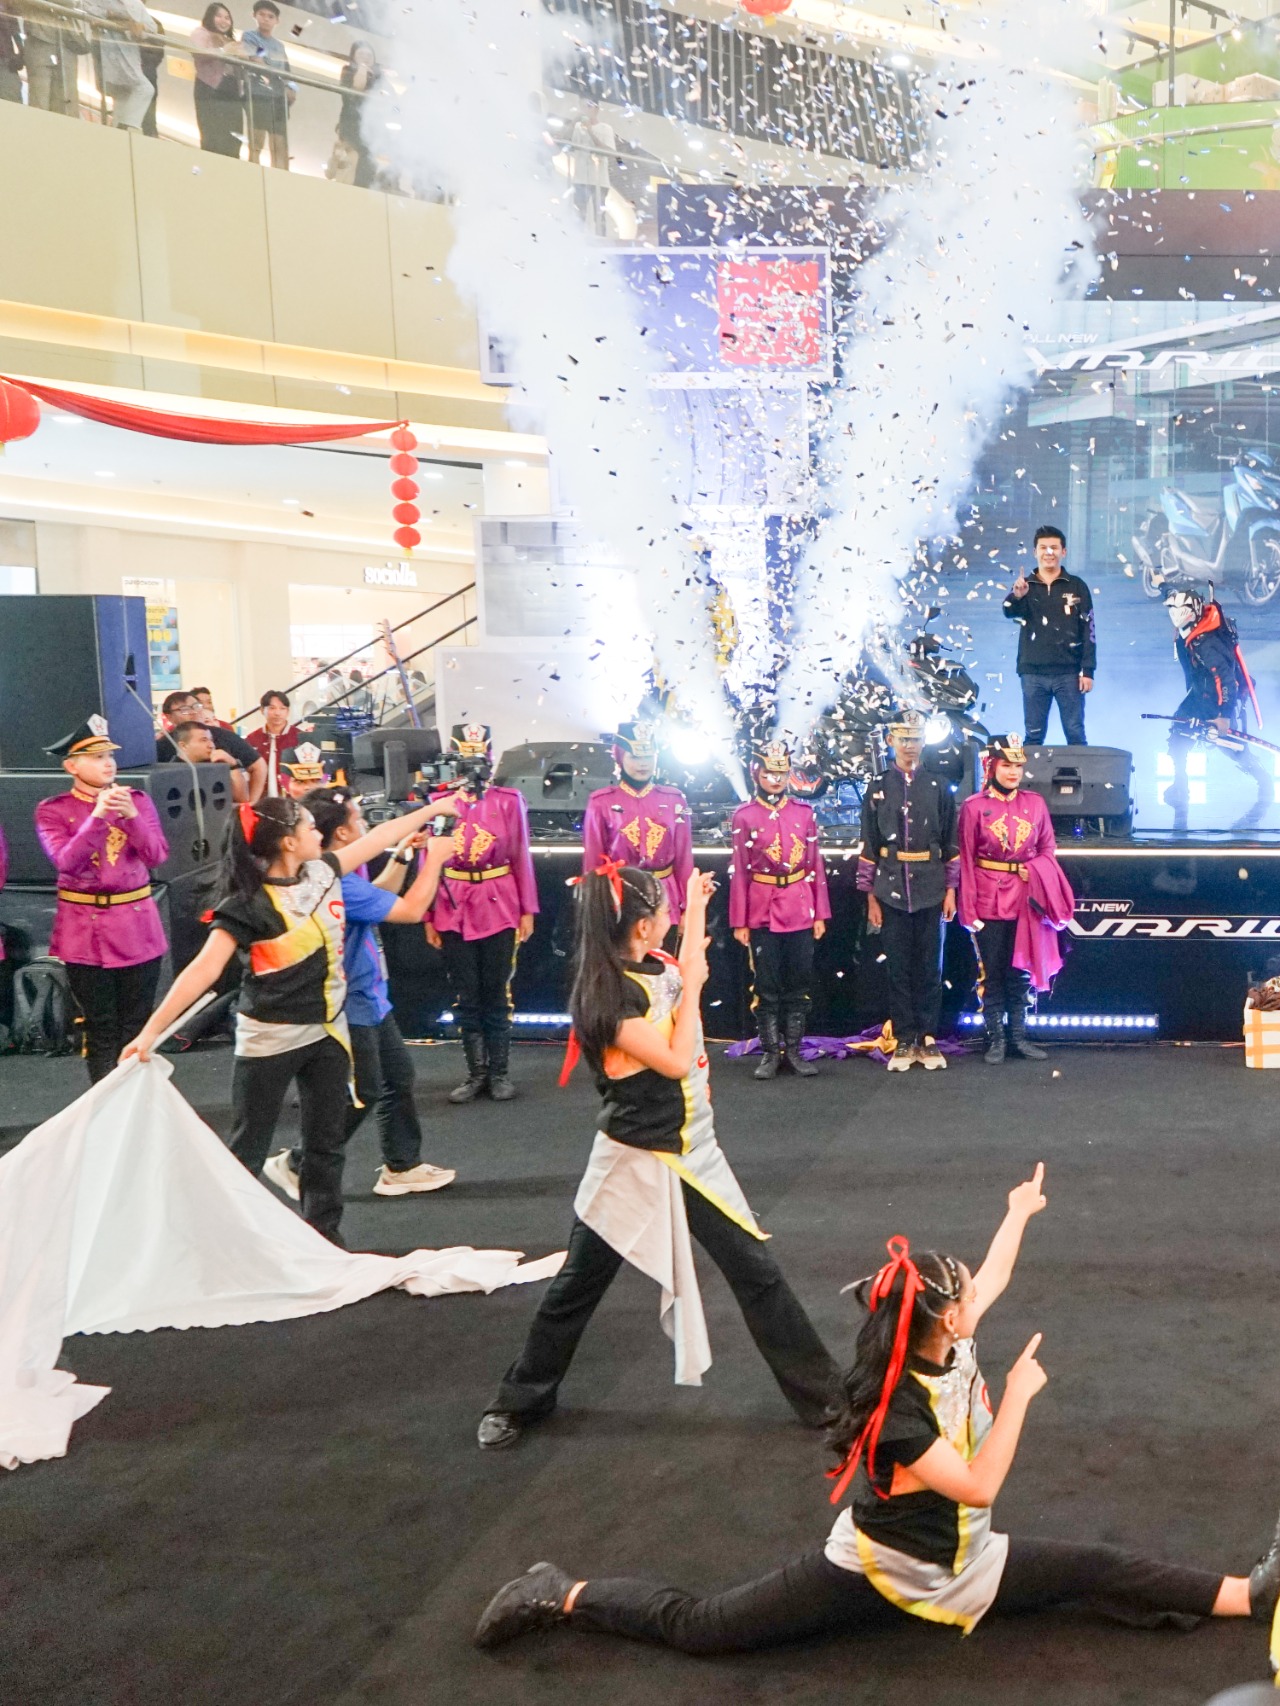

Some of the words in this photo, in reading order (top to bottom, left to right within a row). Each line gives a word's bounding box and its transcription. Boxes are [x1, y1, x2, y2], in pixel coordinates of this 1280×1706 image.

[1058, 332, 1099, 344] NEW
[363, 561, 418, 587] sociolla
[1091, 902, 1130, 912] NEW
